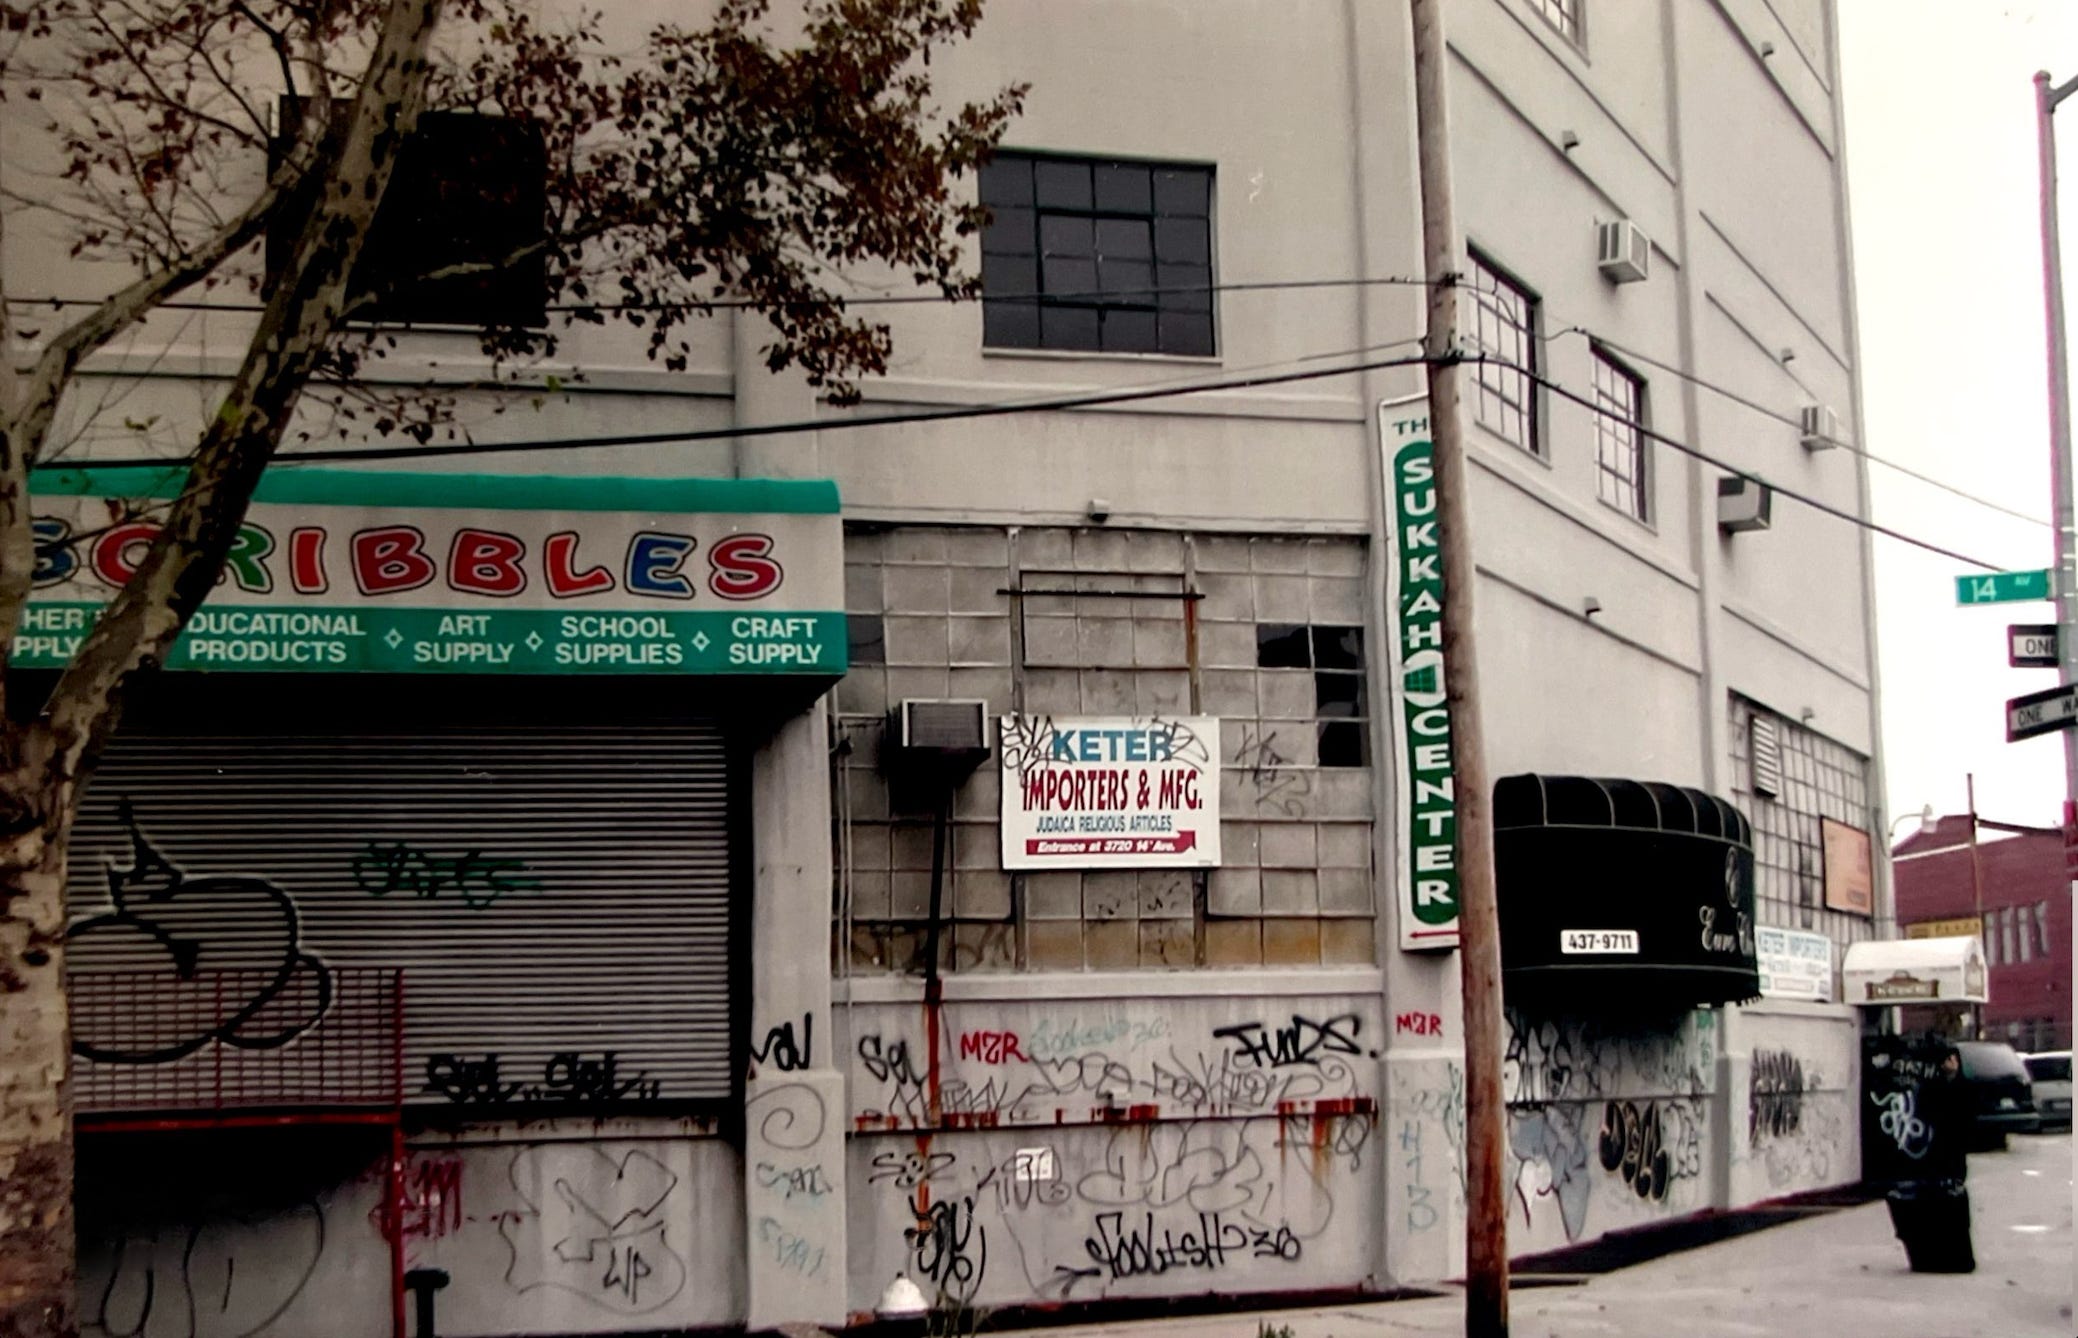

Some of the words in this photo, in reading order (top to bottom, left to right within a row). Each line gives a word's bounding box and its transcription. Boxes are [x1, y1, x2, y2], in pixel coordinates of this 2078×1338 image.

[1393, 417, 1428, 436] TH
[1402, 457, 1442, 650] SUKKAH
[1971, 578, 1997, 602] 14
[187, 612, 366, 636] DUCATIONAL
[438, 615, 491, 637] ART
[560, 615, 675, 640] SCHOOL
[731, 617, 818, 639] CRAFT
[12, 635, 83, 658] PPLY
[189, 639, 347, 662] PRODUCTS
[413, 641, 514, 664] SUPPLY
[555, 642, 683, 665] SUPPLIES
[729, 643, 822, 665] SUPPLY
[2018, 709, 2043, 727] ONE
[1052, 729, 1173, 763] KETER
[1023, 768, 1129, 811] IMPORTERS
[1137, 768, 1150, 809] &
[1158, 768, 1203, 810] MFG.
[1411, 709, 1455, 906] CENTER
[1036, 816, 1075, 833] JUDAICA
[1079, 816, 1125, 832] RELIGIOUS
[1130, 815, 1172, 832] ARTICLES
[1037, 840, 1086, 853] Entrance
[1088, 842, 1102, 852] at
[1104, 841, 1133, 852] 3720
[1568, 933, 1633, 950] 437-9711
